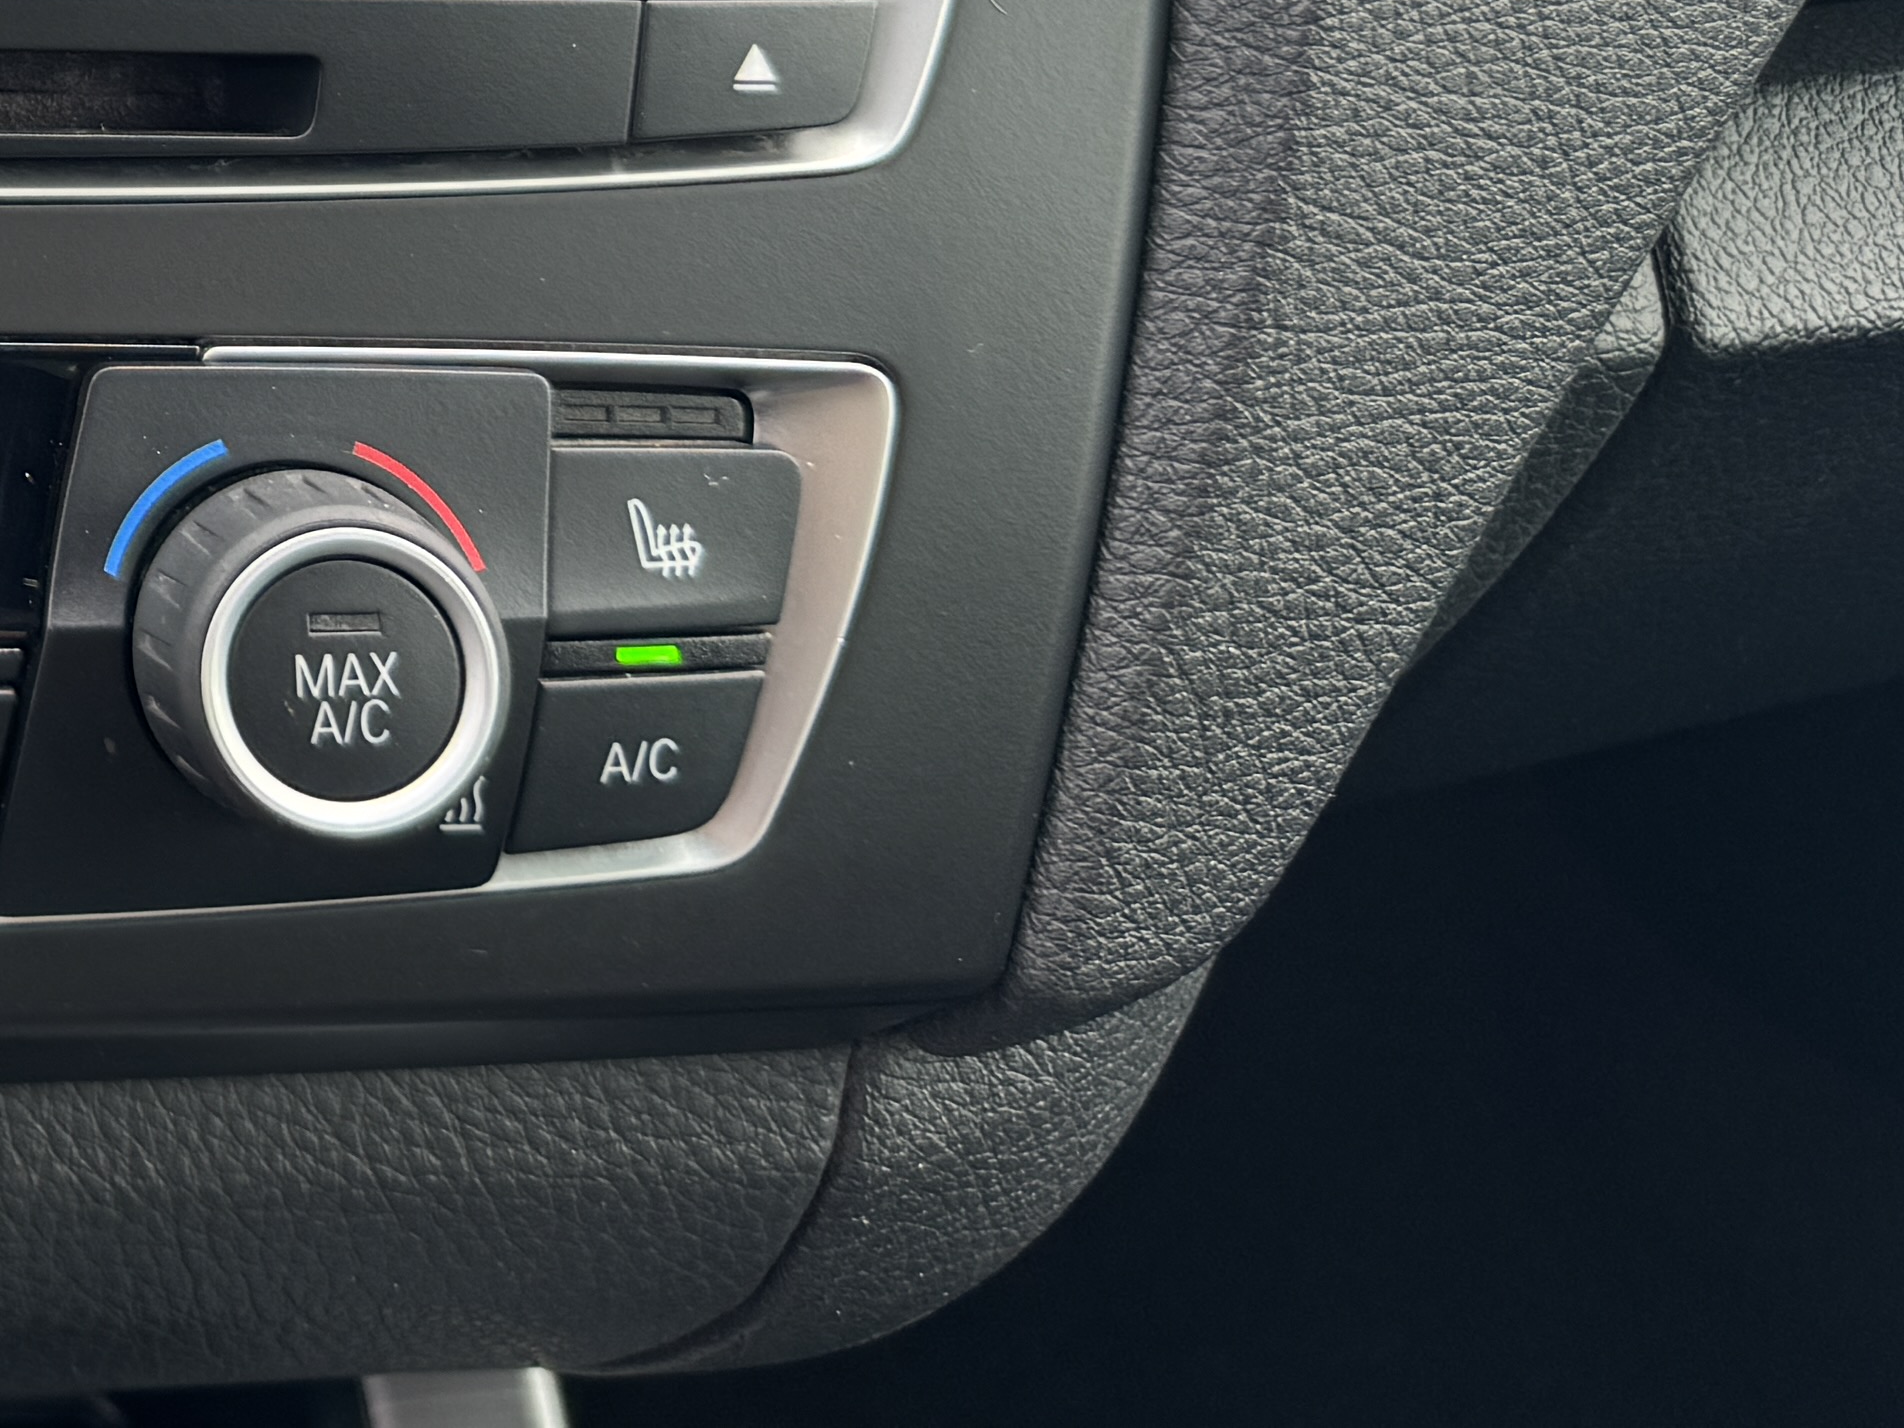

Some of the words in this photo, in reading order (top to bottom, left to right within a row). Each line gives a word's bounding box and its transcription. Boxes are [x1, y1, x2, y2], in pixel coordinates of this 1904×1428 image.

[293, 651, 402, 700] MAX
[309, 698, 393, 747] A/C
[599, 737, 680, 786] A/C
